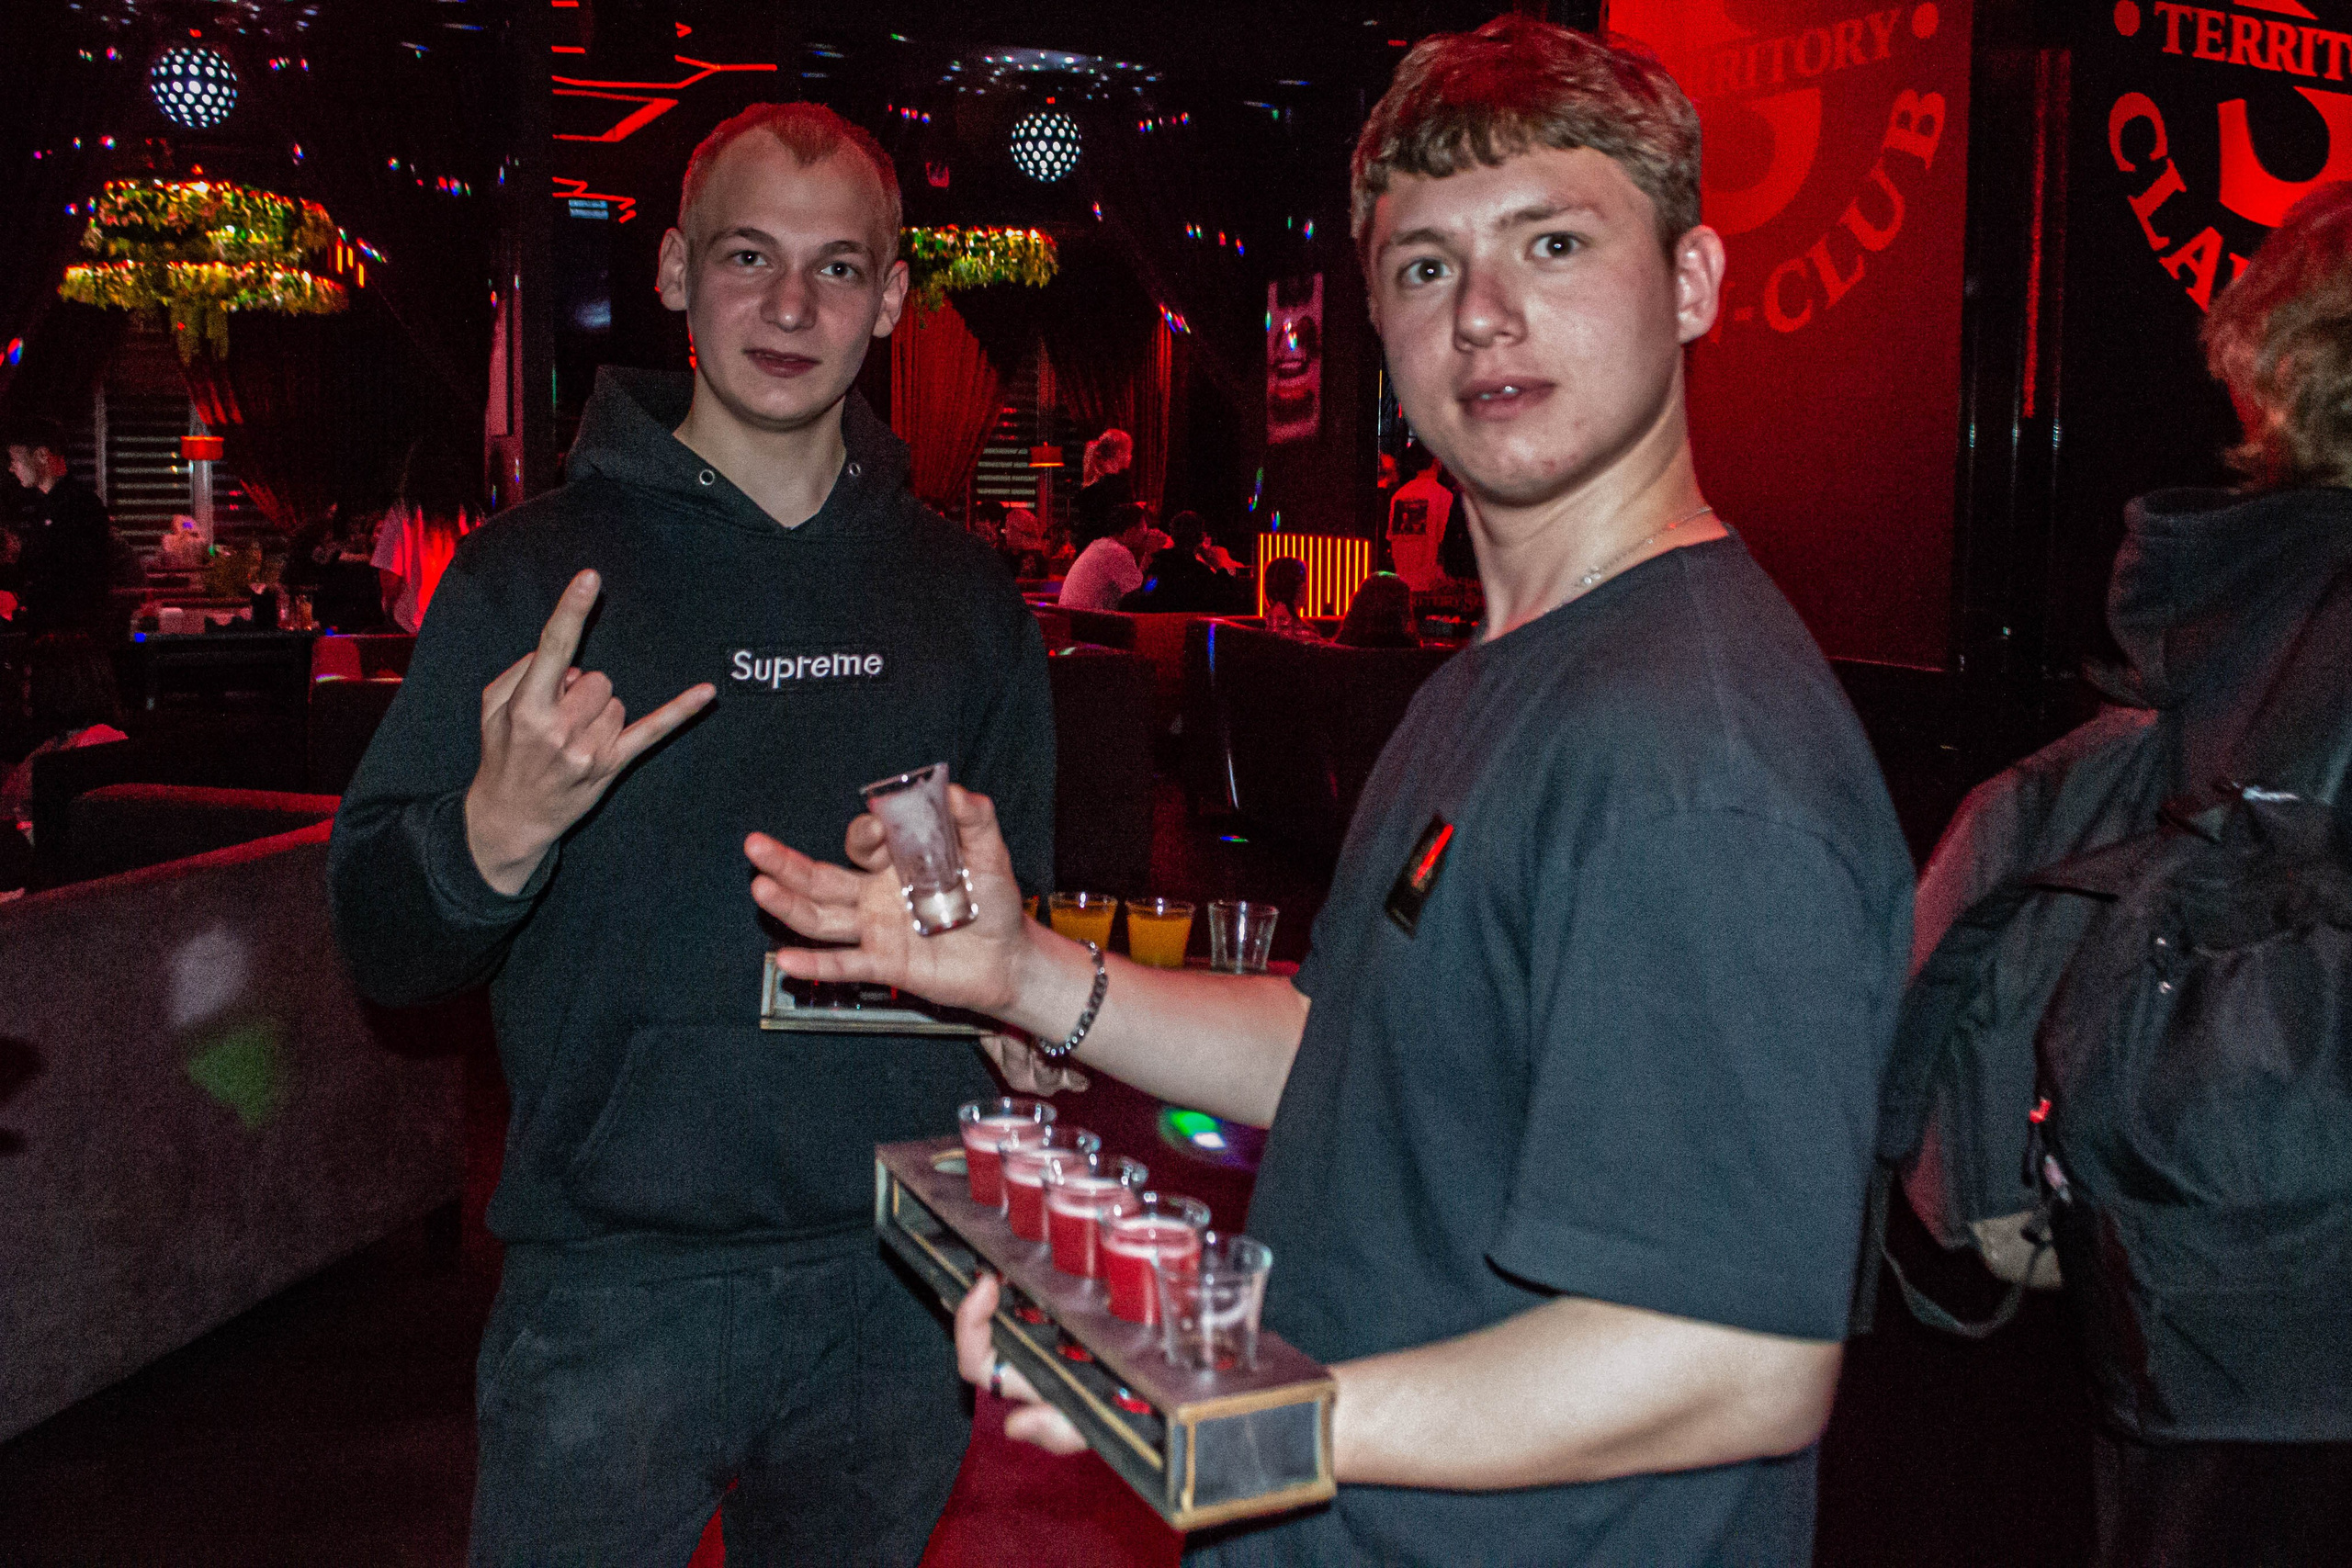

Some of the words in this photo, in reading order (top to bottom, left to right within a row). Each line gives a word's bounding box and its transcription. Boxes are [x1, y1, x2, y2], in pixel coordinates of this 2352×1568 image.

[2155, 2, 2352, 82] TERRIT
[2109, 92, 2251, 313] CLA
[731, 649, 884, 689] Supreme
